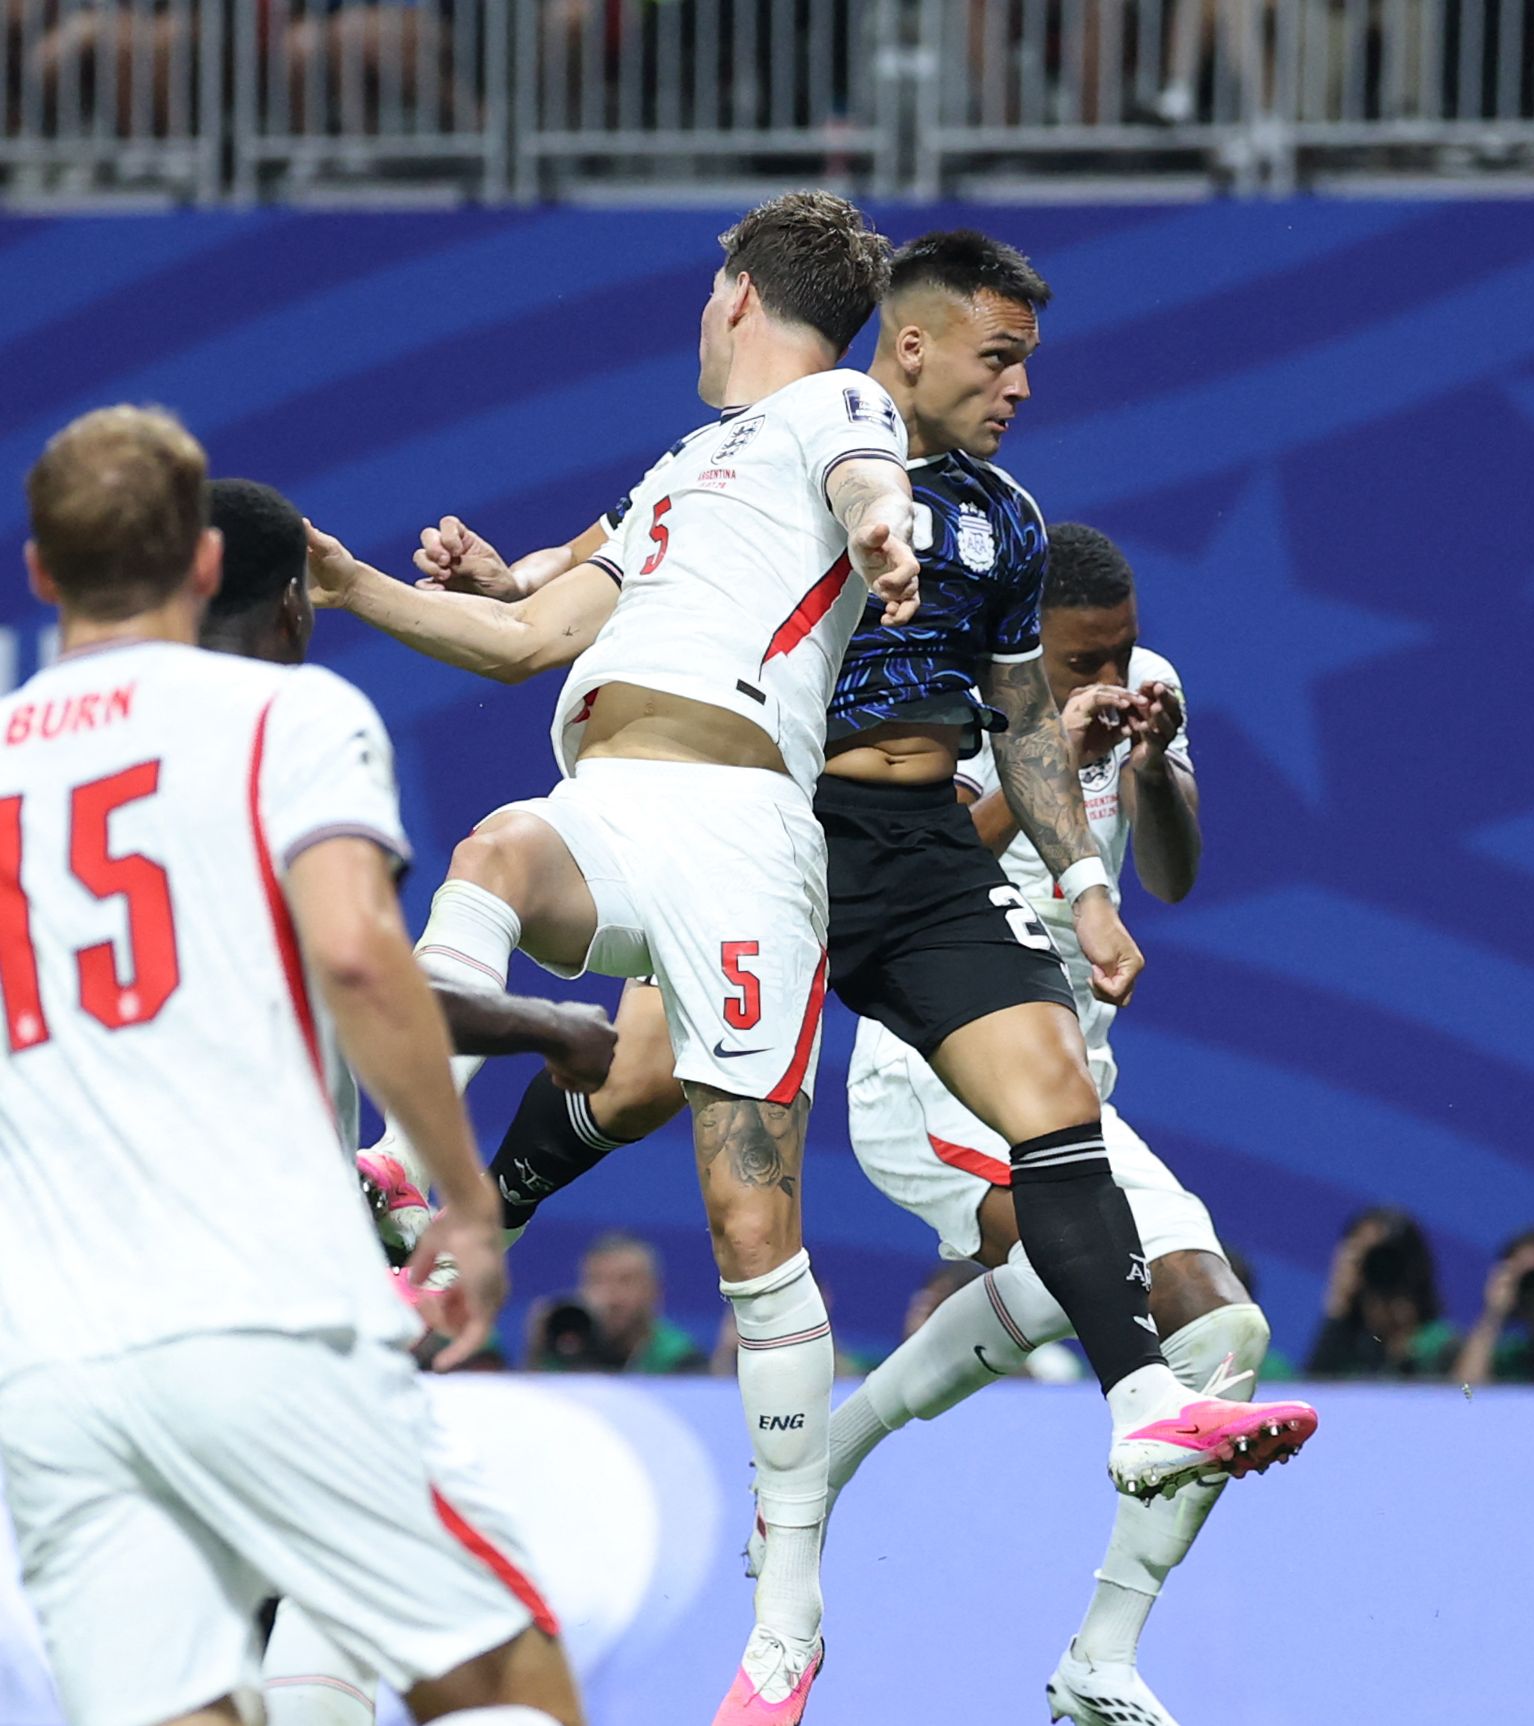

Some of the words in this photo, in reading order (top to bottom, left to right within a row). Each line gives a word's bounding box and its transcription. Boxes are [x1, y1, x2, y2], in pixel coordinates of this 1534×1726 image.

[698, 469, 736, 481] ARGENTINA
[640, 494, 672, 575] 5
[5, 680, 137, 747] BURN
[0, 758, 181, 1054] 15
[721, 940, 761, 1031] 5
[759, 1413, 805, 1431] ENG
